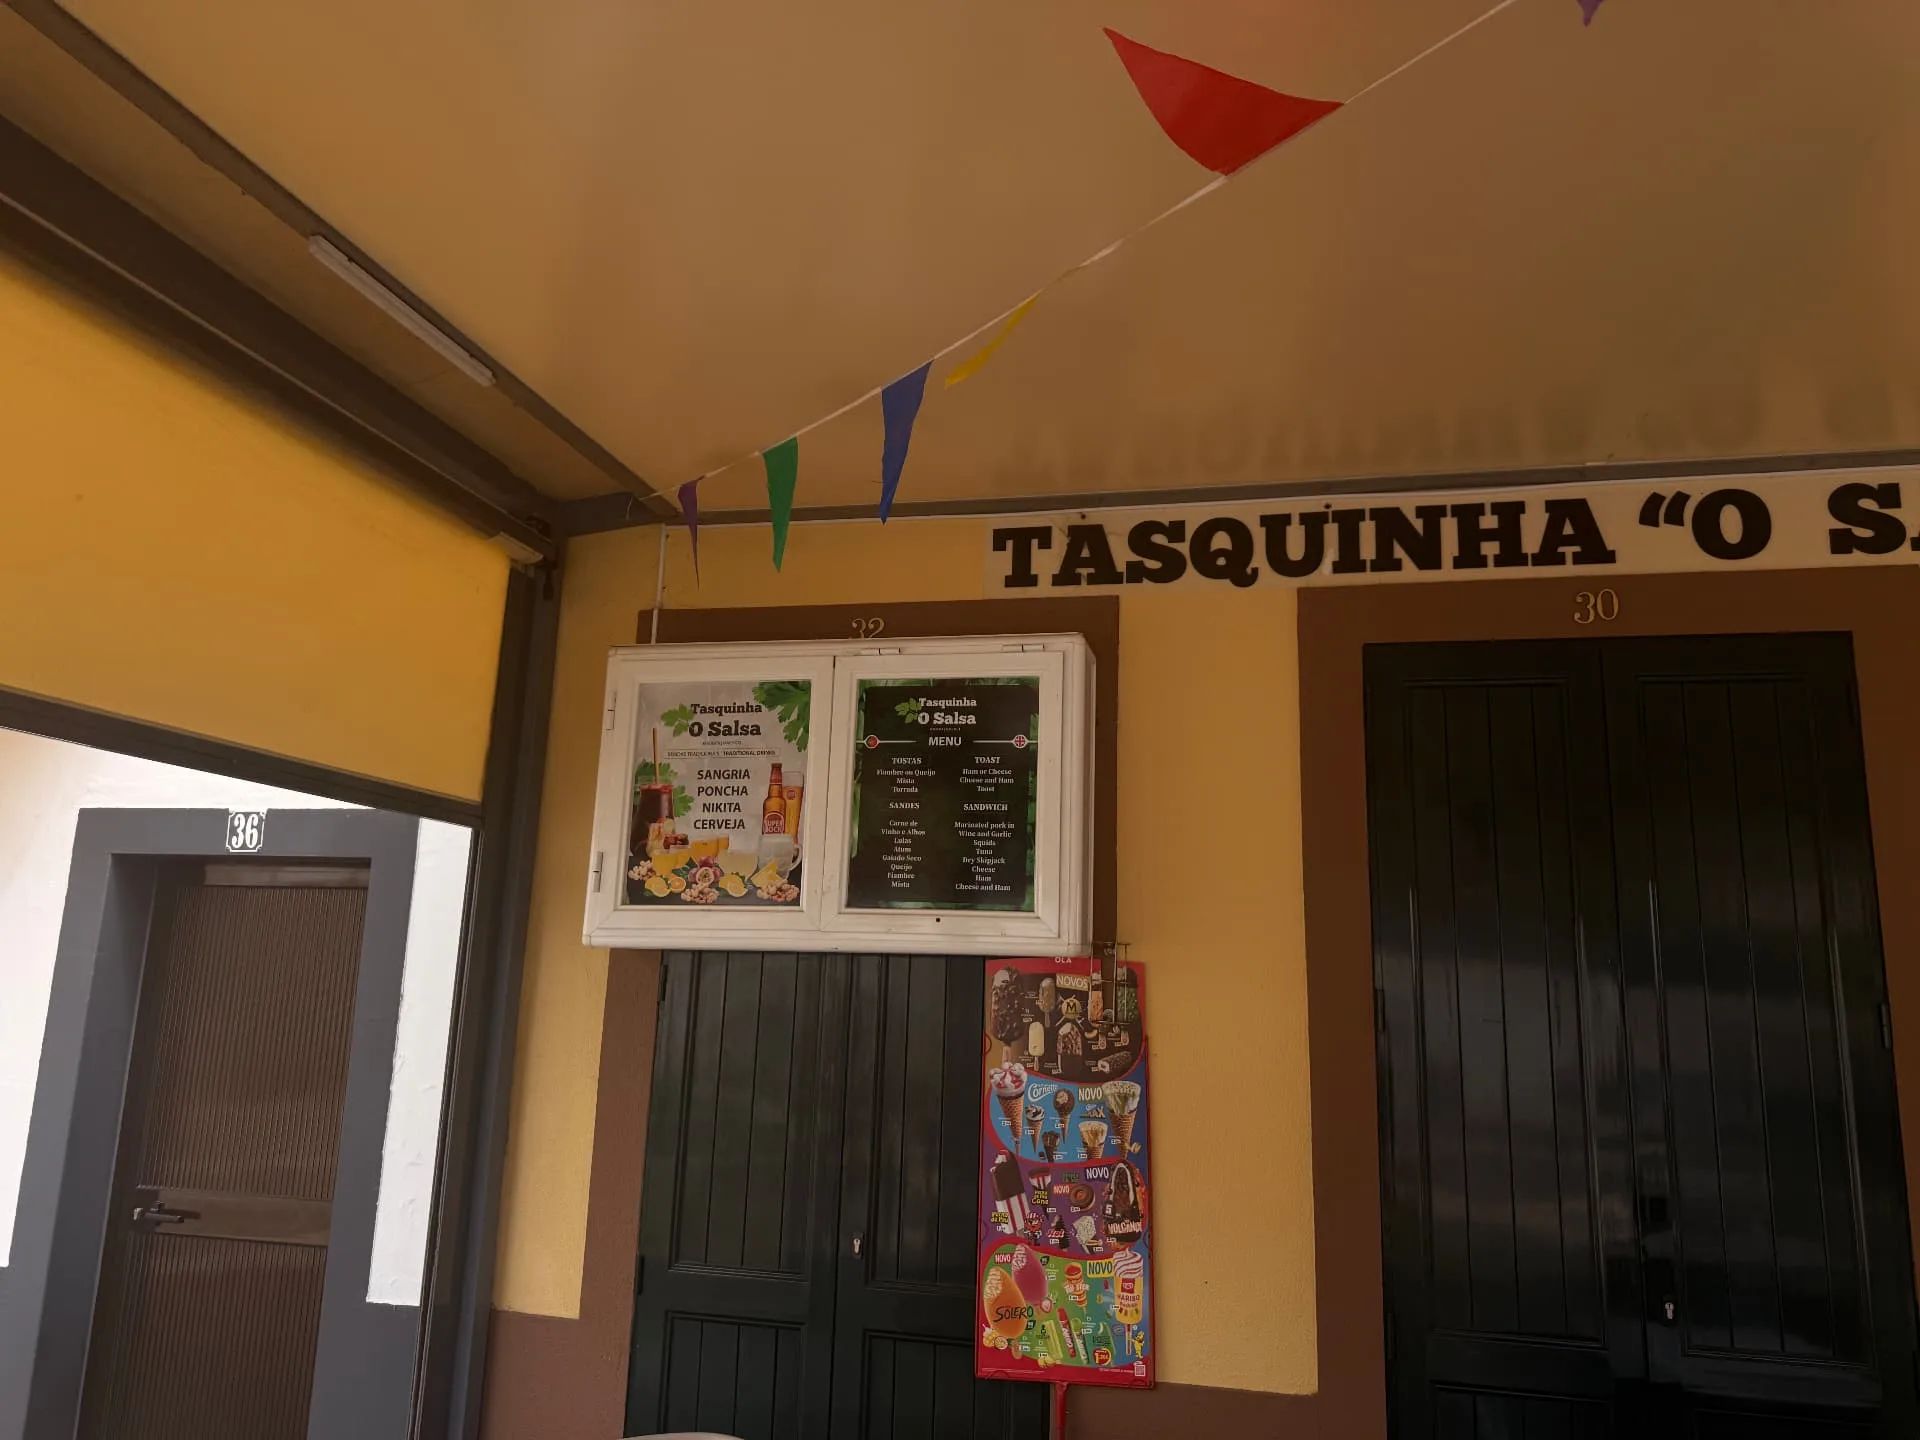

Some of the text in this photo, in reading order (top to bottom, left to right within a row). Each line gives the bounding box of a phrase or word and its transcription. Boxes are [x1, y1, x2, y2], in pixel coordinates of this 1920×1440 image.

[993, 498, 1616, 588] TASQUINHA
[1828, 482, 1920, 555] S
[1573, 588, 1619, 624] 30
[691, 702, 763, 716] Tasquinha
[919, 696, 977, 709] Tasquinha
[918, 711, 977, 725] O Salsa
[689, 720, 762, 737] O Salsa
[928, 736, 962, 747] MENU
[892, 757, 923, 765] TOSTAS
[974, 756, 1001, 764] TOAST
[697, 769, 751, 780] SANGRIA
[697, 786, 749, 797] PONCHA
[702, 802, 742, 813] NIKITA
[963, 803, 1008, 811] SANDWICH
[231, 813, 259, 849] 36
[694, 819, 746, 830] CERVEJA
[1056, 975, 1089, 989] NOVOS
[1078, 1087, 1103, 1101] NOVO
[1086, 1167, 1109, 1180] NOVO
[1053, 1184, 1070, 1194] NOVO
[994, 1254, 1011, 1264] NOVO
[1088, 1261, 1113, 1275] NOVO
[993, 1305, 1034, 1322] SOLERO
